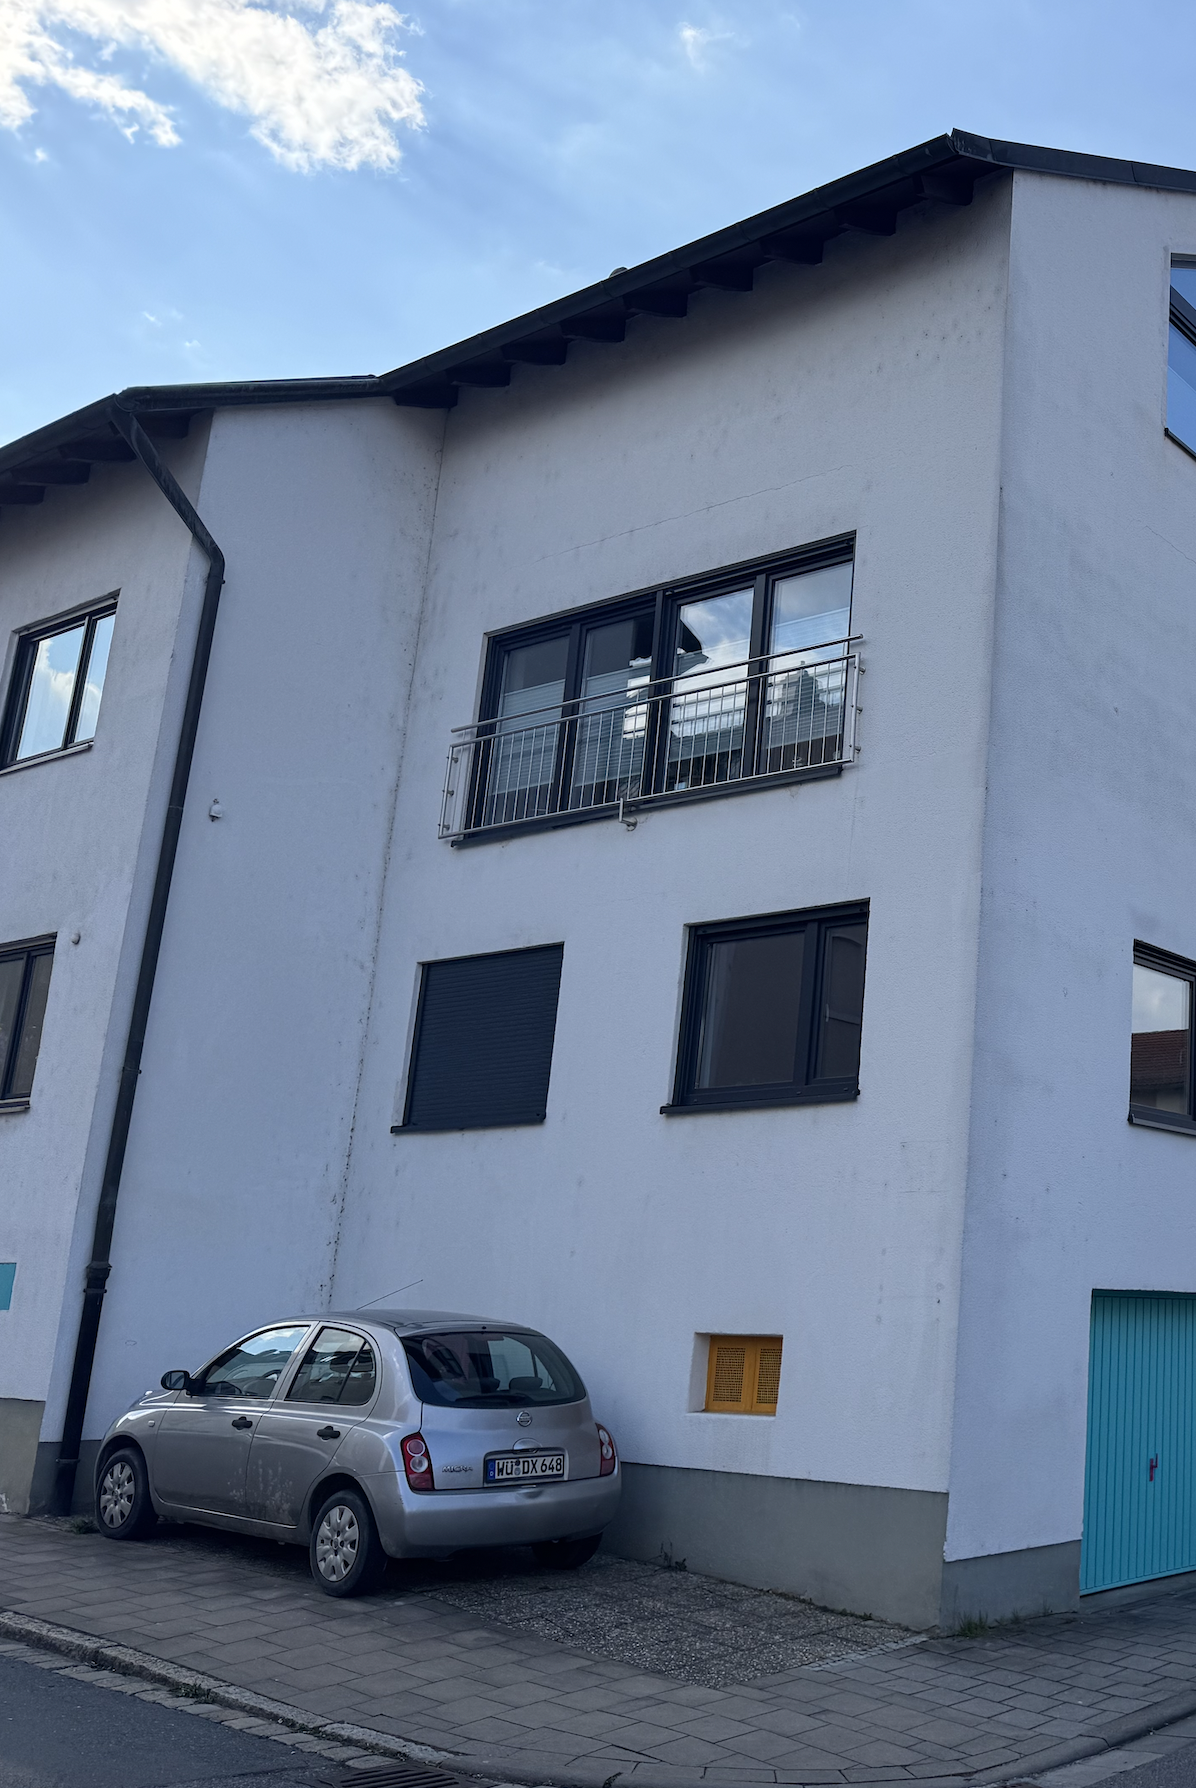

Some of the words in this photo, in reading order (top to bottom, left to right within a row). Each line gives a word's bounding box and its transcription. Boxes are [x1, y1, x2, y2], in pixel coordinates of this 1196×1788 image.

[497, 1461, 513, 1477] WÜ
[522, 1459, 538, 1475] DX
[540, 1458, 562, 1473] 648
